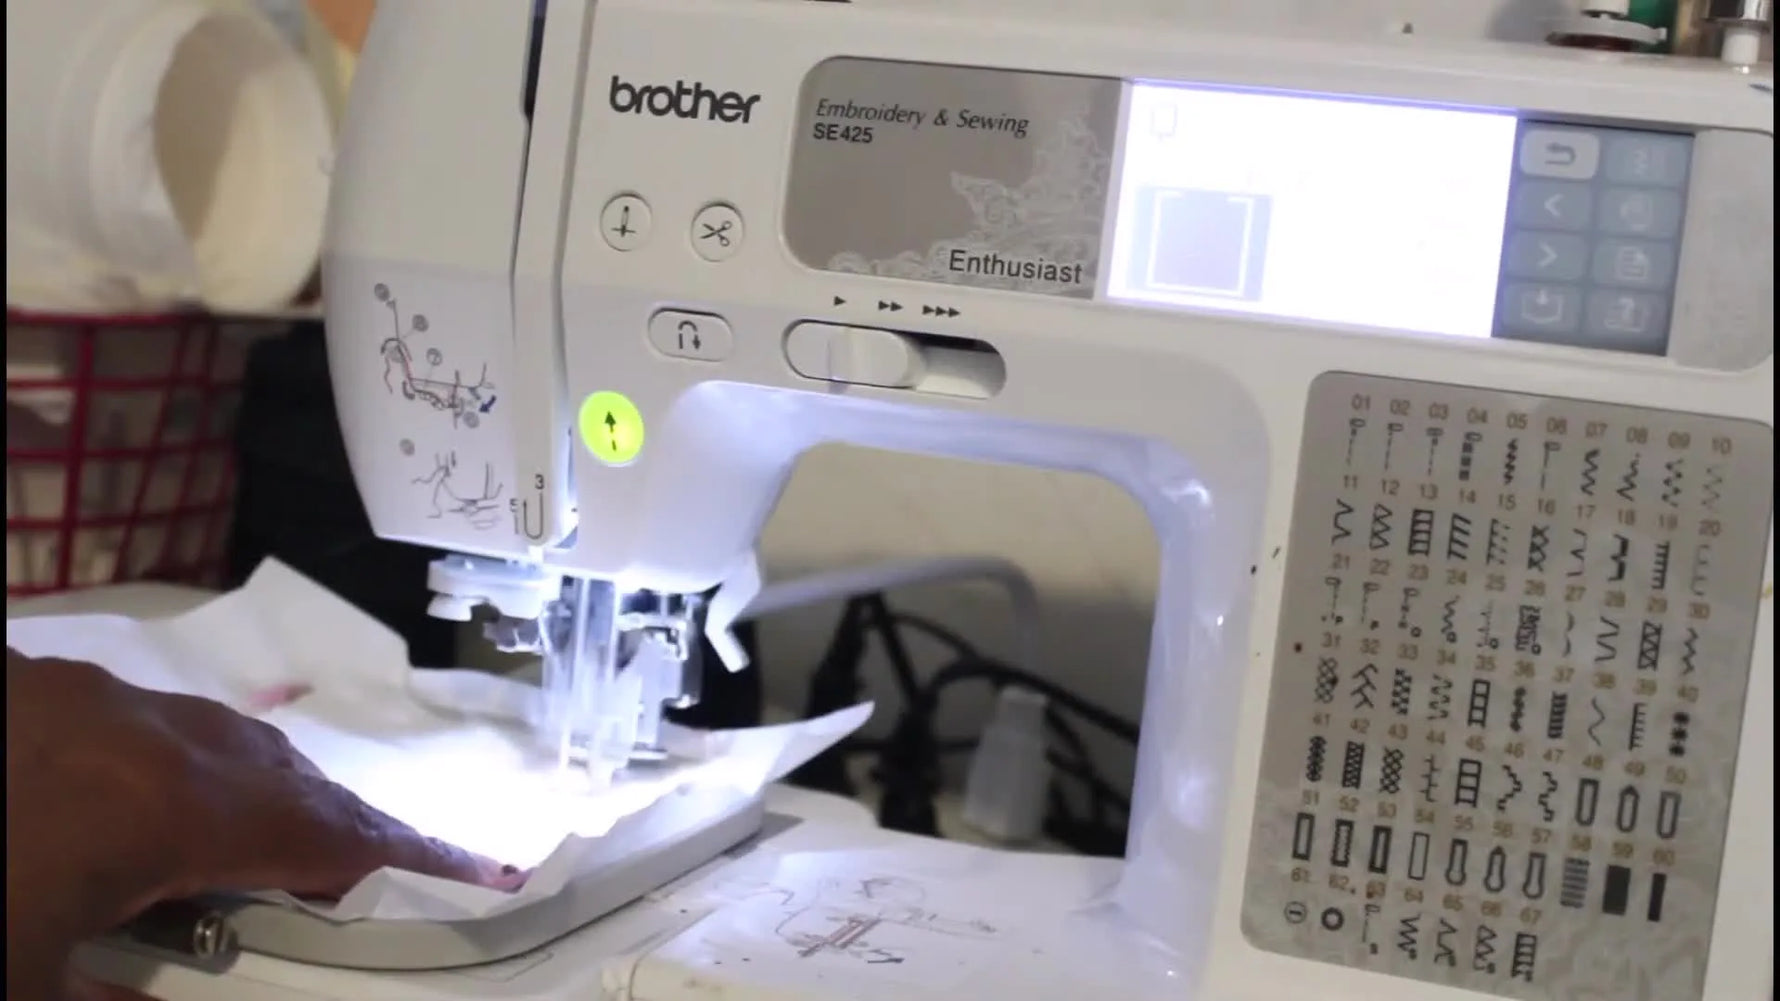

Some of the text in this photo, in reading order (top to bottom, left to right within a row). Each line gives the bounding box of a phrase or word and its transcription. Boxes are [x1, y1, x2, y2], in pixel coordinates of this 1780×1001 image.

[609, 76, 760, 121] brother
[816, 99, 1030, 138] Embroidery & Sewing
[813, 123, 874, 144] SE425
[949, 250, 1082, 285] Enthusiast
[1352, 395, 1370, 411] 01
[1390, 400, 1410, 416] 02
[1429, 404, 1448, 421] 03
[1467, 409, 1488, 425] 04
[1507, 414, 1528, 429] 05
[1546, 417, 1567, 434] 06
[1586, 422, 1607, 438] 07
[1711, 438, 1732, 454] 10
[535, 474, 545, 490] 3
[1343, 475, 1358, 490] 11
[1381, 480, 1399, 496] 12
[1419, 484, 1437, 500] 13
[1458, 489, 1476, 505] 14
[1497, 494, 1516, 510] 15
[1537, 499, 1555, 515] 16
[1577, 504, 1595, 520] 17
[1617, 509, 1635, 526] 18
[1658, 515, 1677, 530] 19
[1331, 555, 1350, 570] 21
[1370, 559, 1390, 576] 22
[1446, 571, 1467, 587] 24
[1485, 576, 1506, 592] 25
[1565, 585, 1586, 601] 27
[1322, 633, 1341, 648] 31
[1360, 639, 1380, 654] 32
[1437, 650, 1457, 666] 34
[1475, 655, 1496, 671] 35
[1554, 667, 1574, 683] 37
[1313, 712, 1330, 727] 41
[1350, 718, 1370, 734] 42
[1426, 729, 1446, 745] 44
[1543, 748, 1563, 764] 47
[1339, 796, 1359, 812] 52
[1531, 827, 1552, 844] 57
[1612, 841, 1634, 858] 59
